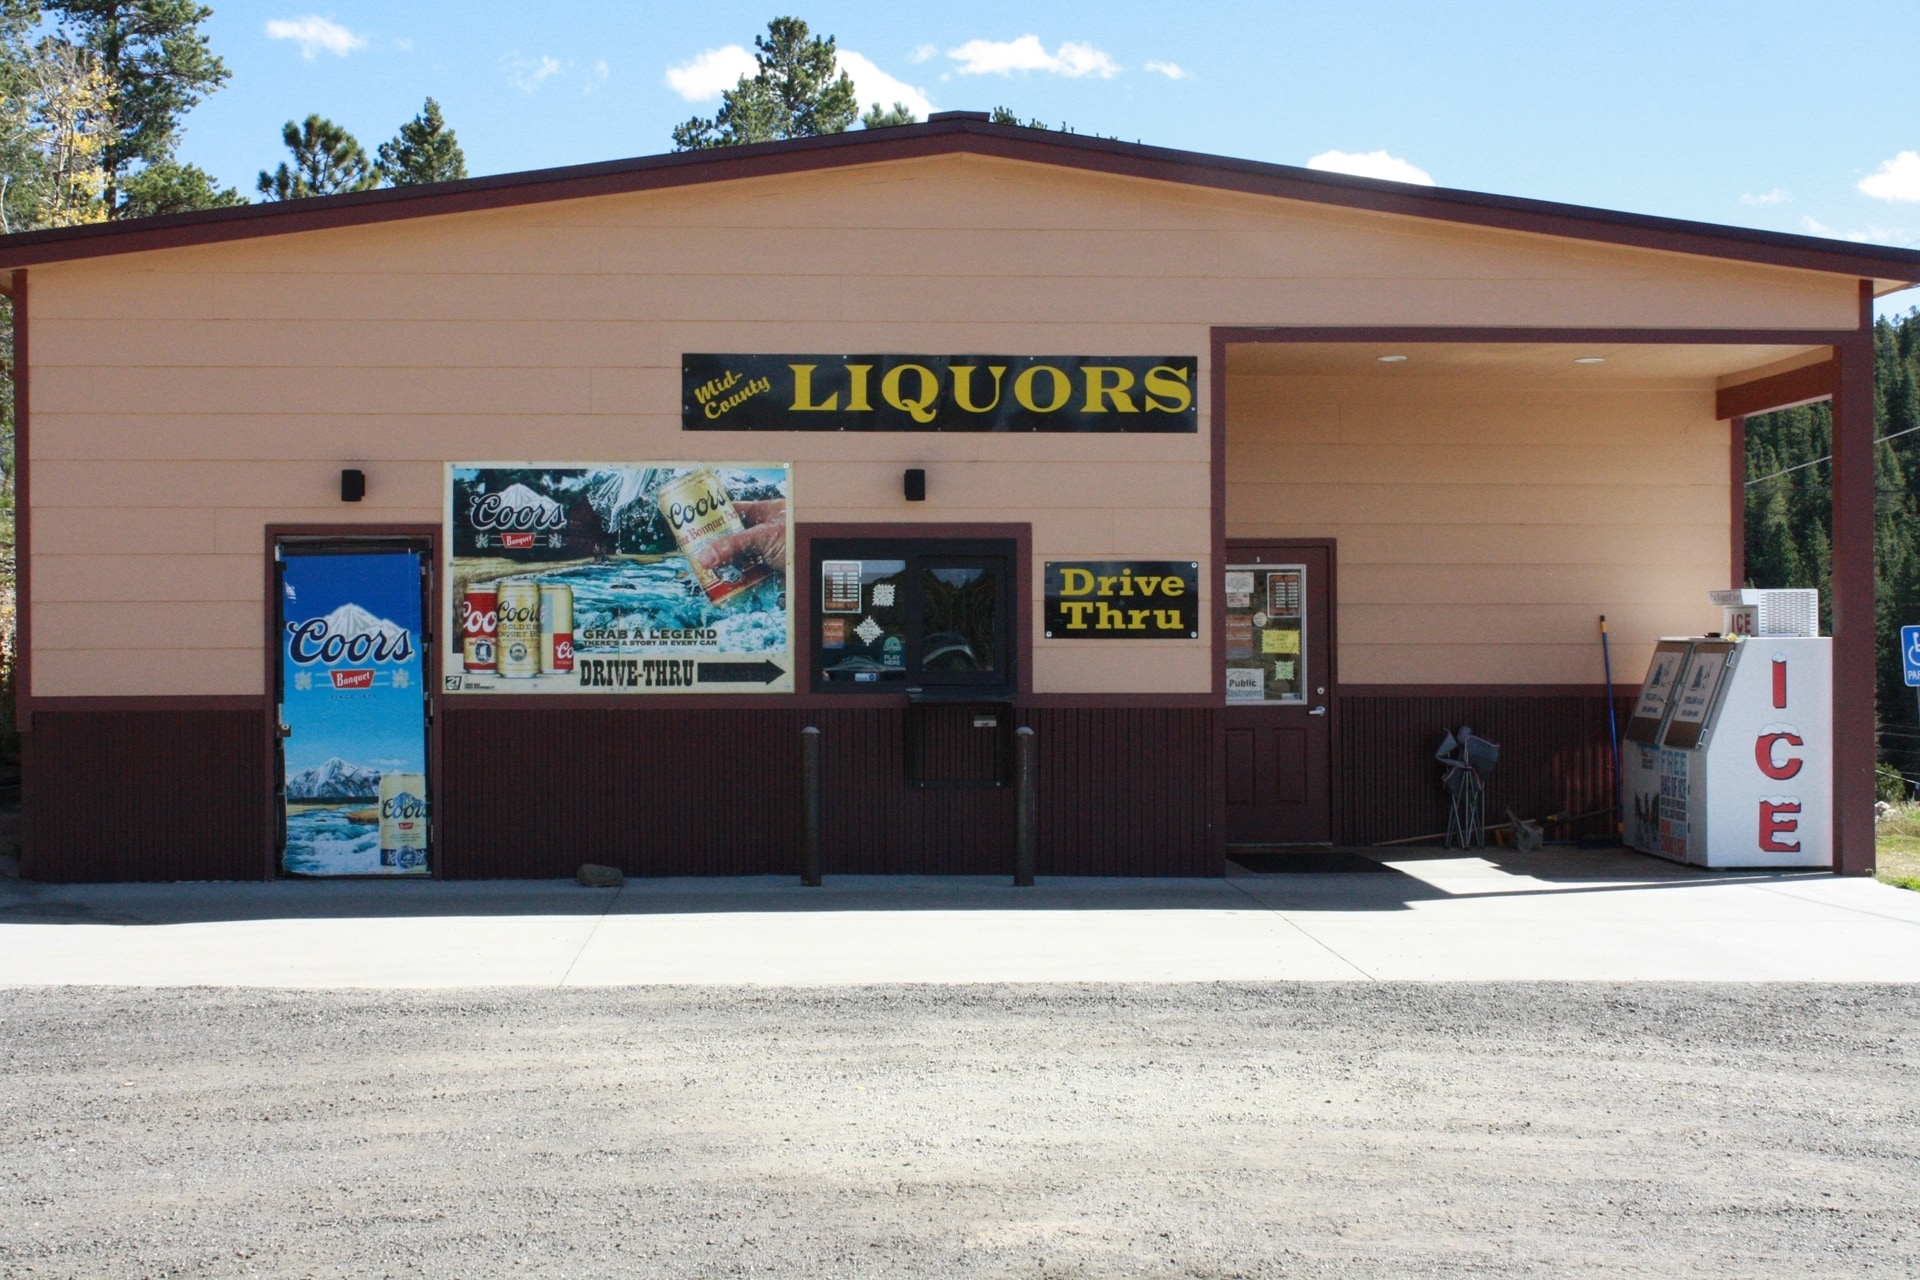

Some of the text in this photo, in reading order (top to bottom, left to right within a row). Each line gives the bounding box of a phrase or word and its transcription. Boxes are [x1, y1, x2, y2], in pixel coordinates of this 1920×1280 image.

[694, 370, 743, 404] Mid-
[704, 376, 771, 419] County
[788, 364, 1192, 423] LIQUORS
[470, 493, 566, 530] Coors
[668, 487, 726, 530] Coors
[506, 536, 532, 547] Banquet
[1060, 568, 1185, 596] Drive
[1060, 602, 1184, 629] Thru
[1731, 613, 1751, 633] ICE
[287, 618, 414, 663] Coors
[583, 630, 717, 639] GRAB A LEGEND
[336, 672, 370, 687] Banquet
[580, 660, 694, 686] DRIVE-THRU
[1229, 679, 1256, 687] Public
[1661, 750, 1687, 777] FREE
[1755, 653, 1803, 852] ICE
